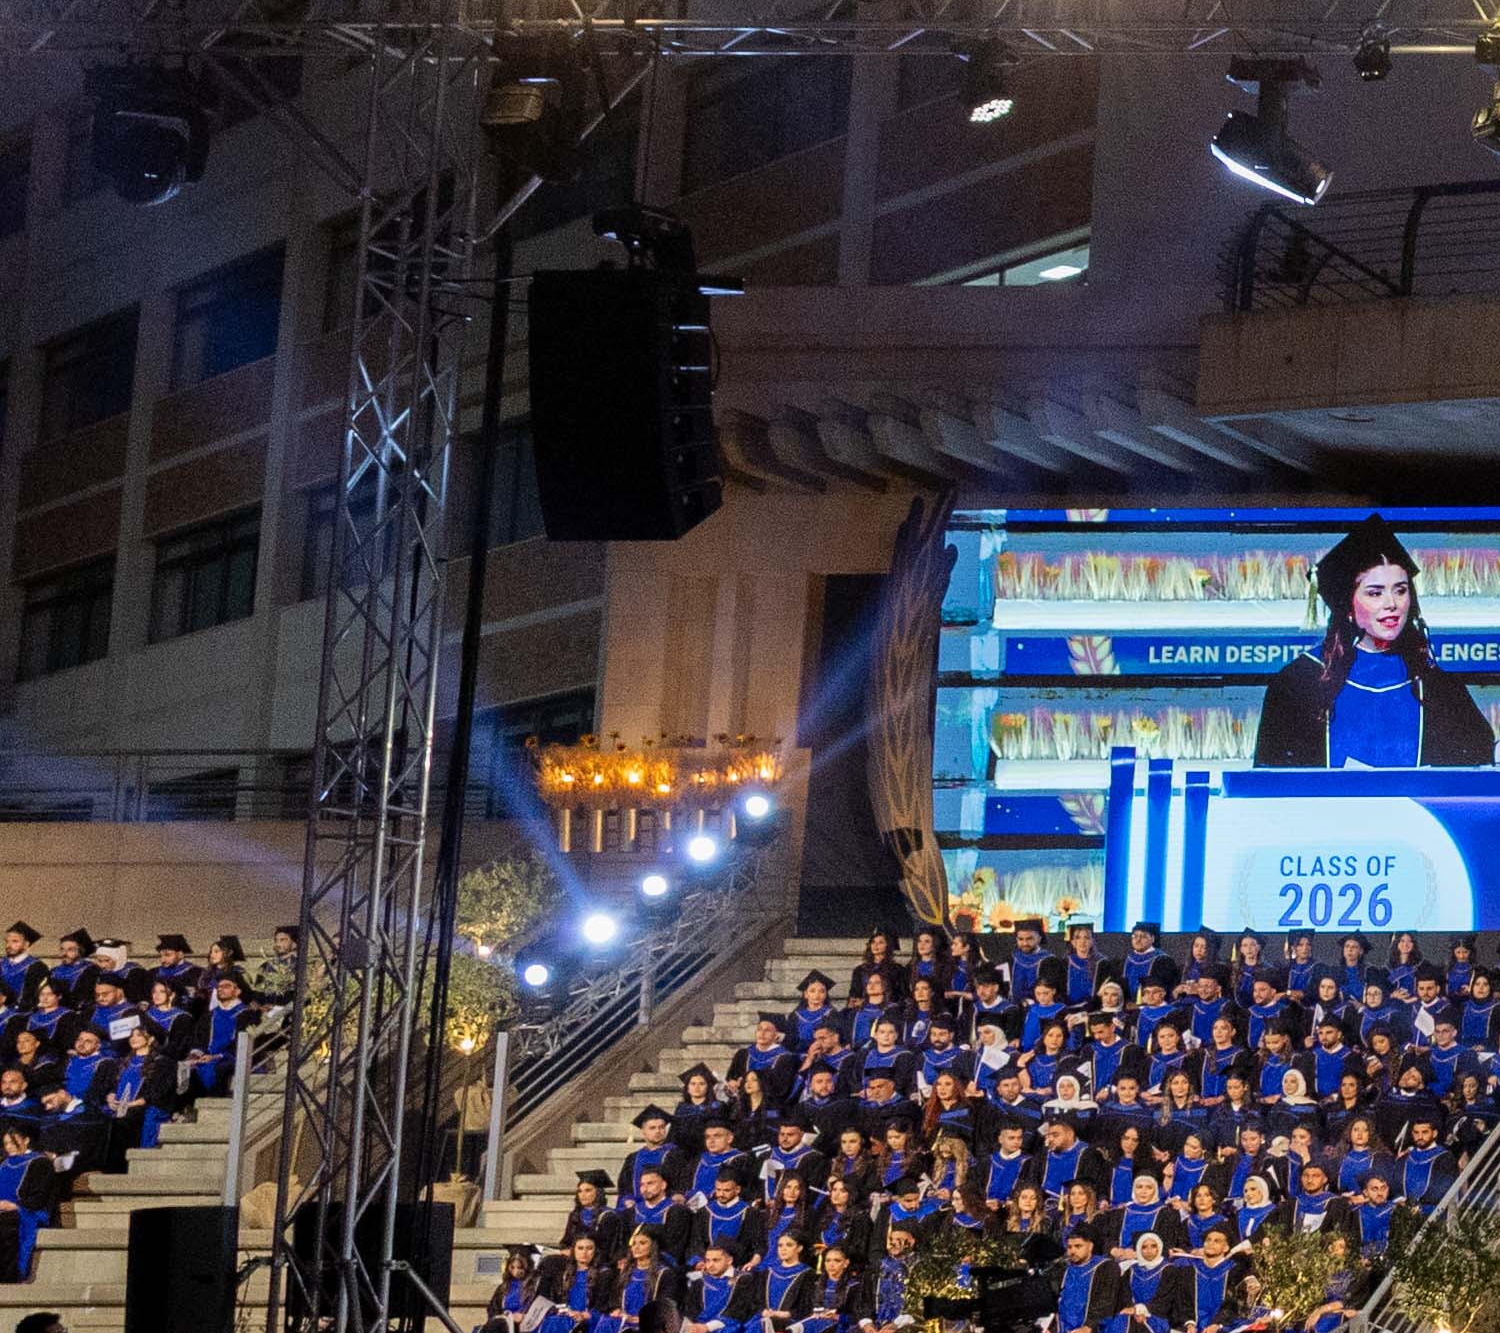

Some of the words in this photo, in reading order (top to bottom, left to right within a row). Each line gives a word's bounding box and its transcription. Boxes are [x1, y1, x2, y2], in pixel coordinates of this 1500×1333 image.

[1149, 645, 1220, 664] LEARN
[1225, 644, 1312, 664] DESPIT
[1280, 856, 1358, 877] CLASS
[1366, 856, 1396, 877] OF
[1278, 883, 1393, 927] 2026
